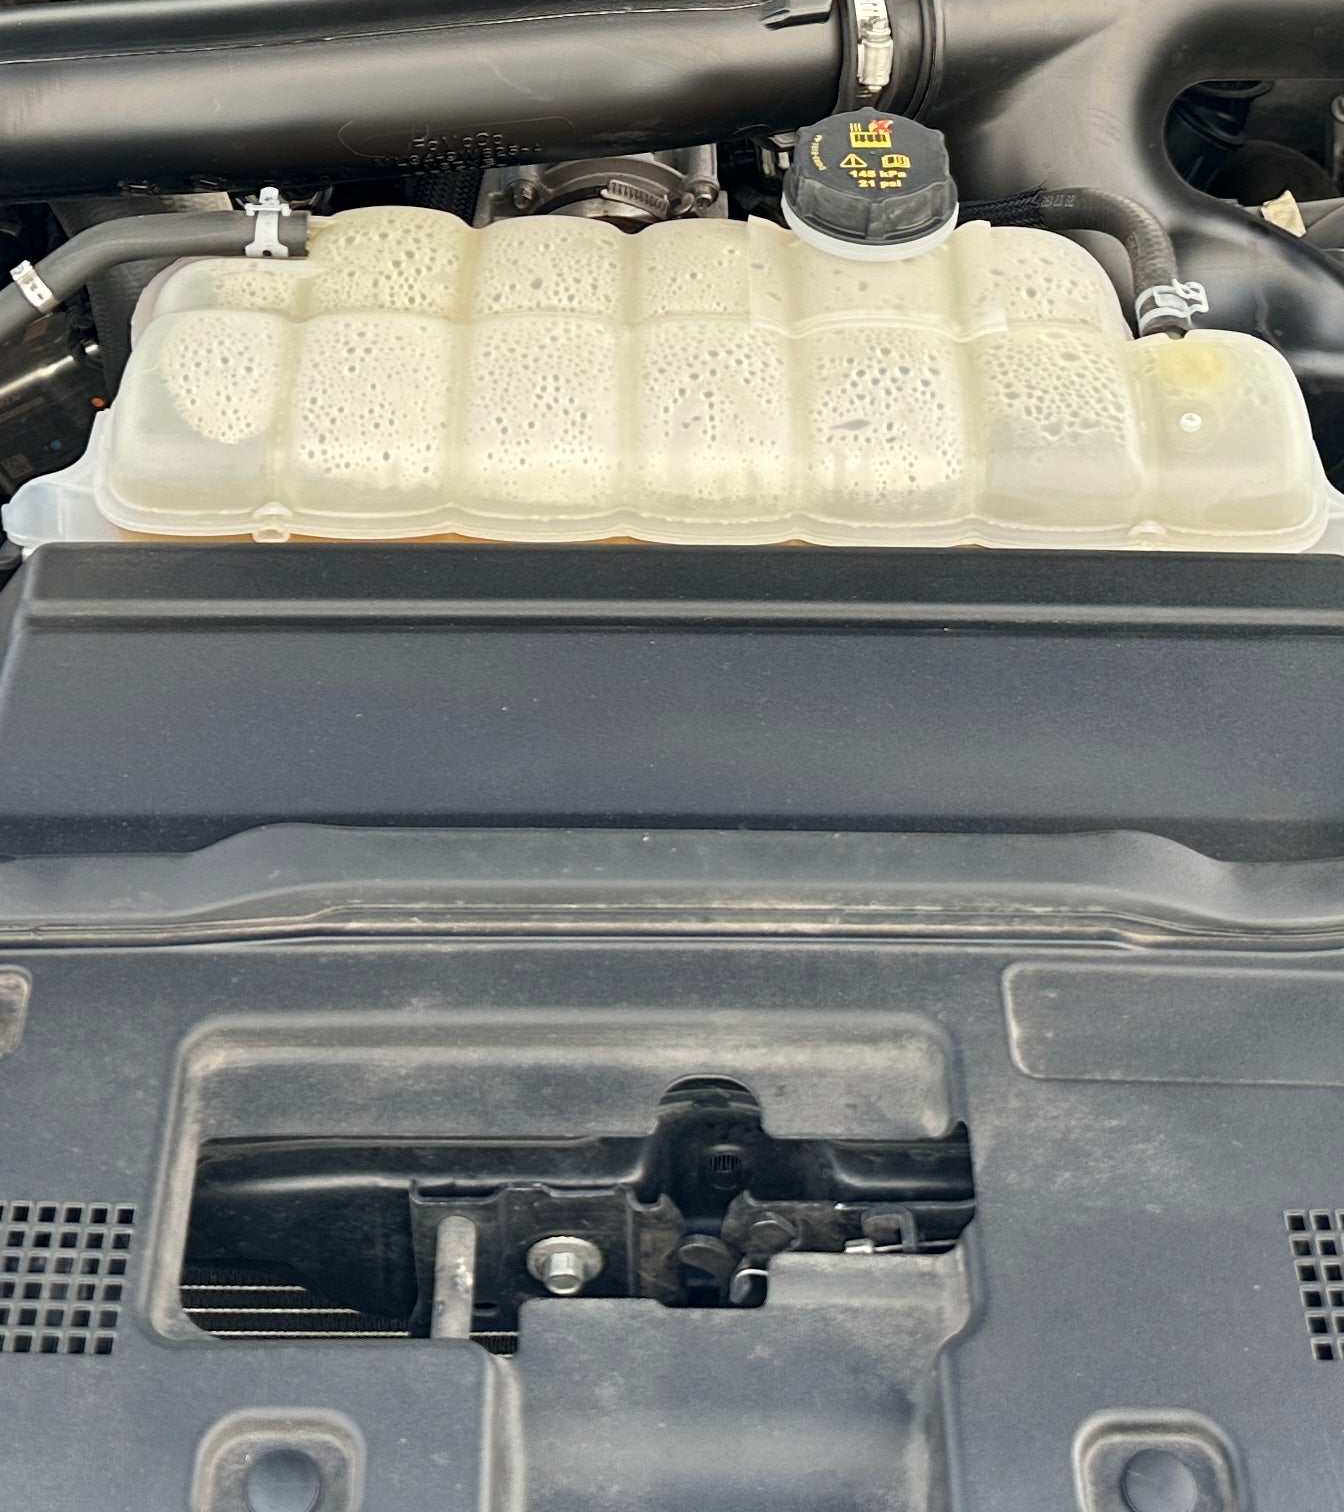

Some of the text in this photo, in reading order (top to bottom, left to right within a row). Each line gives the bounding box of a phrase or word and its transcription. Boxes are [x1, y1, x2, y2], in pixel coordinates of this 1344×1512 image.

[880, 170, 907, 178] kPa
[859, 179, 902, 188] 21 psi
